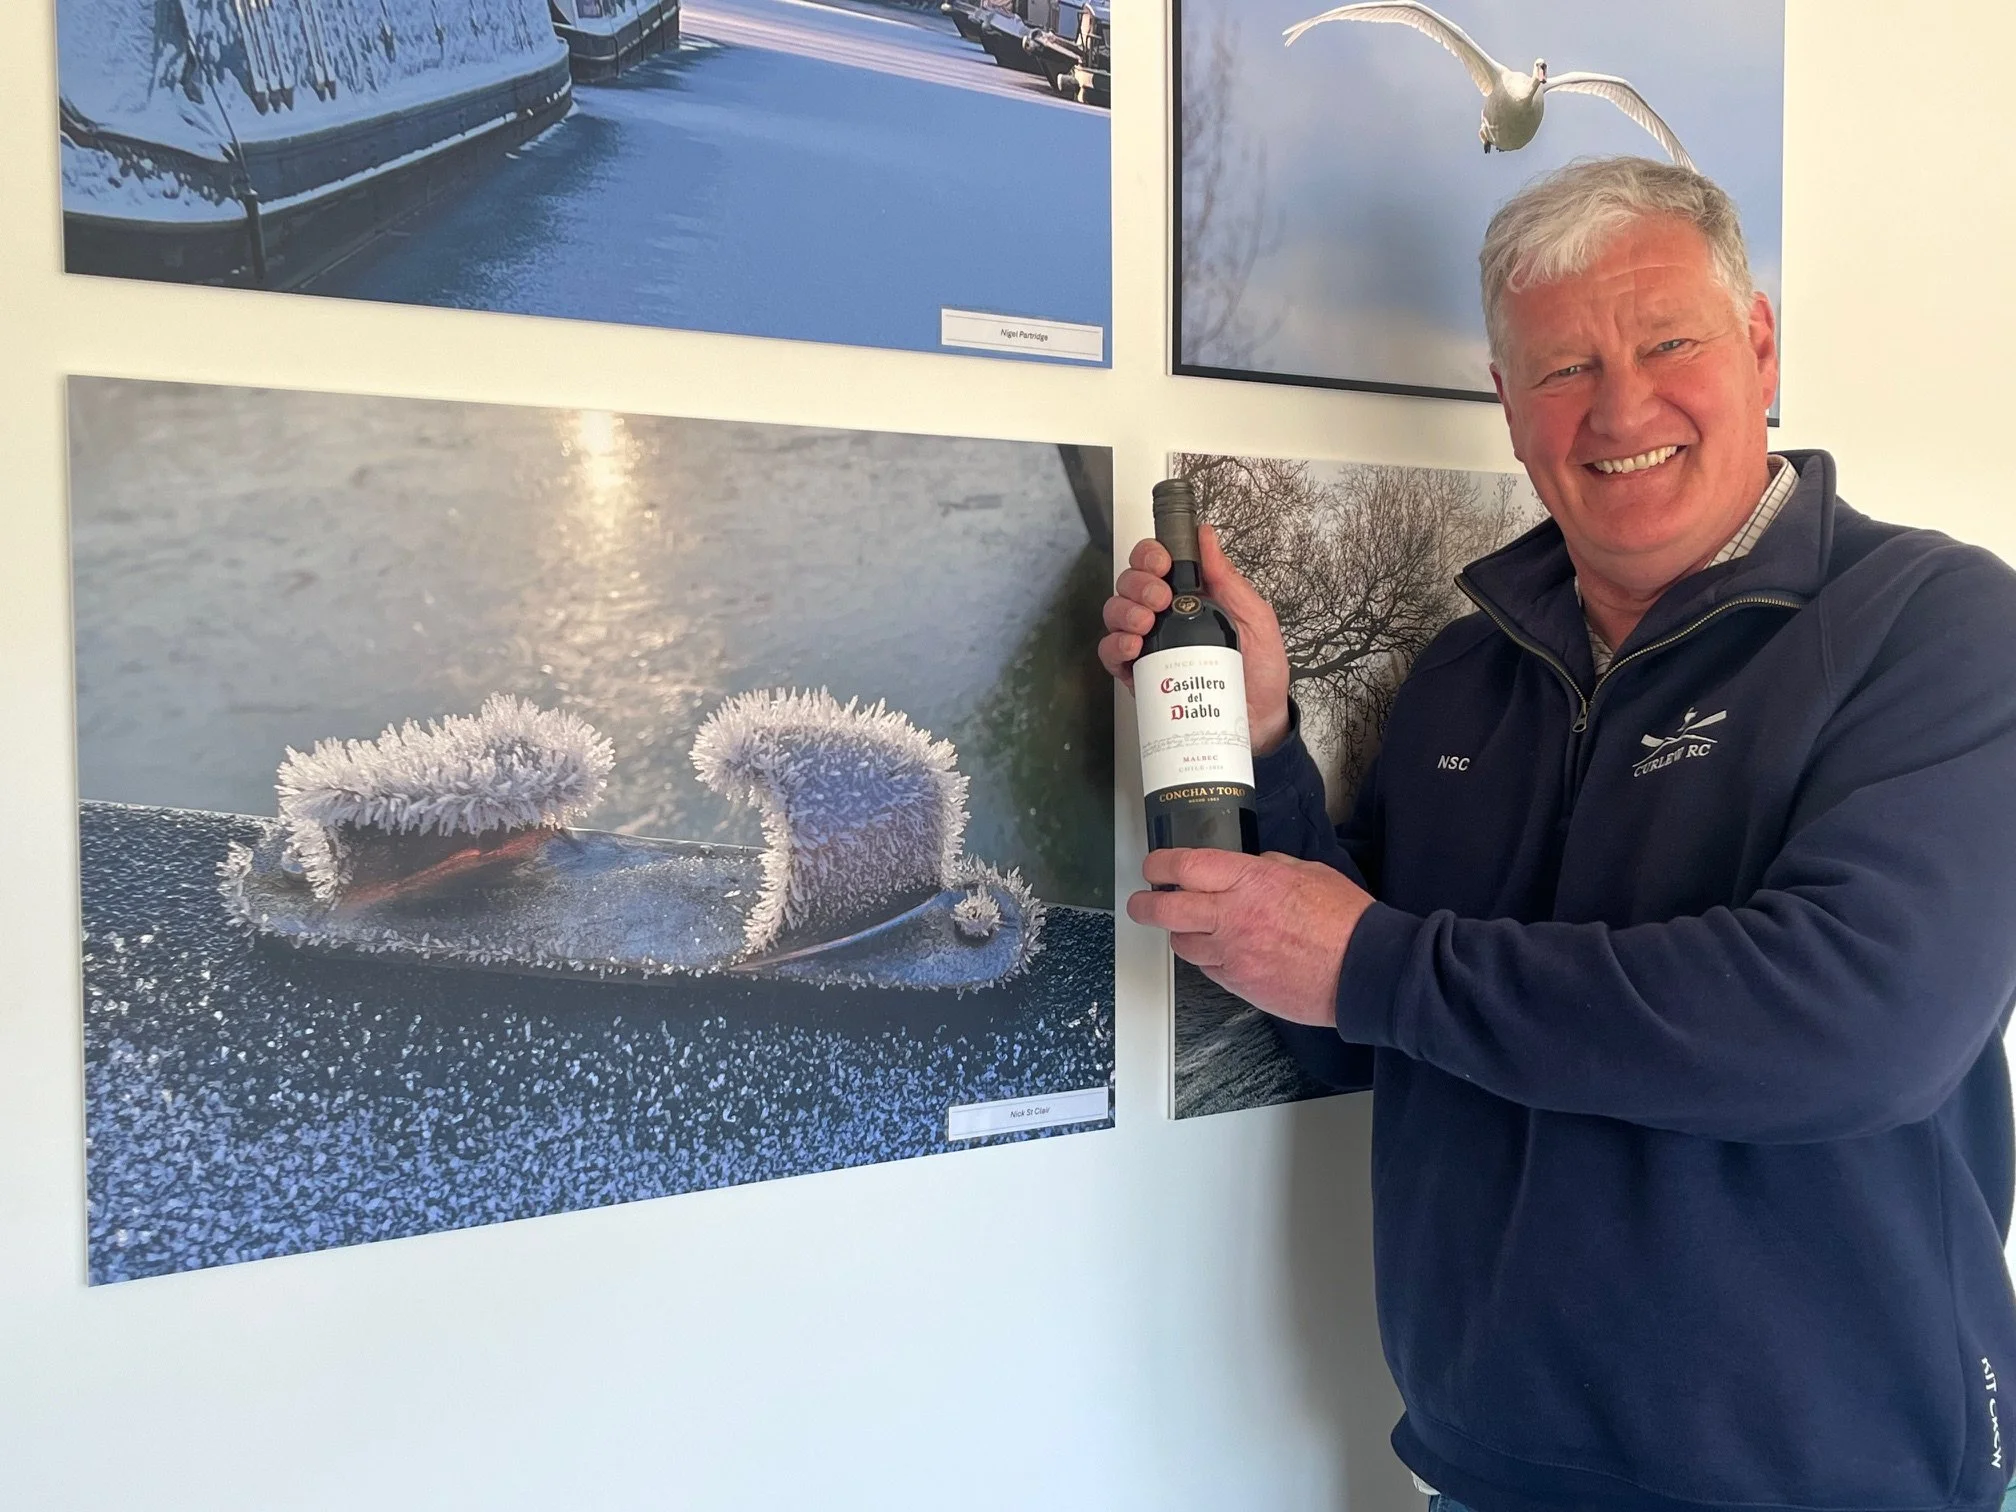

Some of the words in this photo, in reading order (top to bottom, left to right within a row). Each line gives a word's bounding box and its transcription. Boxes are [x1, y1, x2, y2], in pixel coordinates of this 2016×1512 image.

[1000, 328, 1019, 339] Nigel
[1019, 330, 1049, 342] Partridge
[1160, 676, 1225, 694] Casillero
[1187, 692, 1203, 703] del
[1170, 704, 1220, 721] Diablo
[1183, 754, 1218, 763] MALBEC
[1437, 754, 1471, 771] NSC
[1633, 746, 1685, 778] CURLEW
[1685, 744, 1711, 758] RC
[1159, 787, 1207, 803] CONCHA
[1208, 787, 1215, 795] Y
[1216, 786, 1246, 798] TORO
[1010, 1110, 1025, 1118] Nick
[1026, 1108, 1034, 1116] St
[1034, 1106, 1051, 1115] Clair
[1981, 1356, 1997, 1392] KIT
